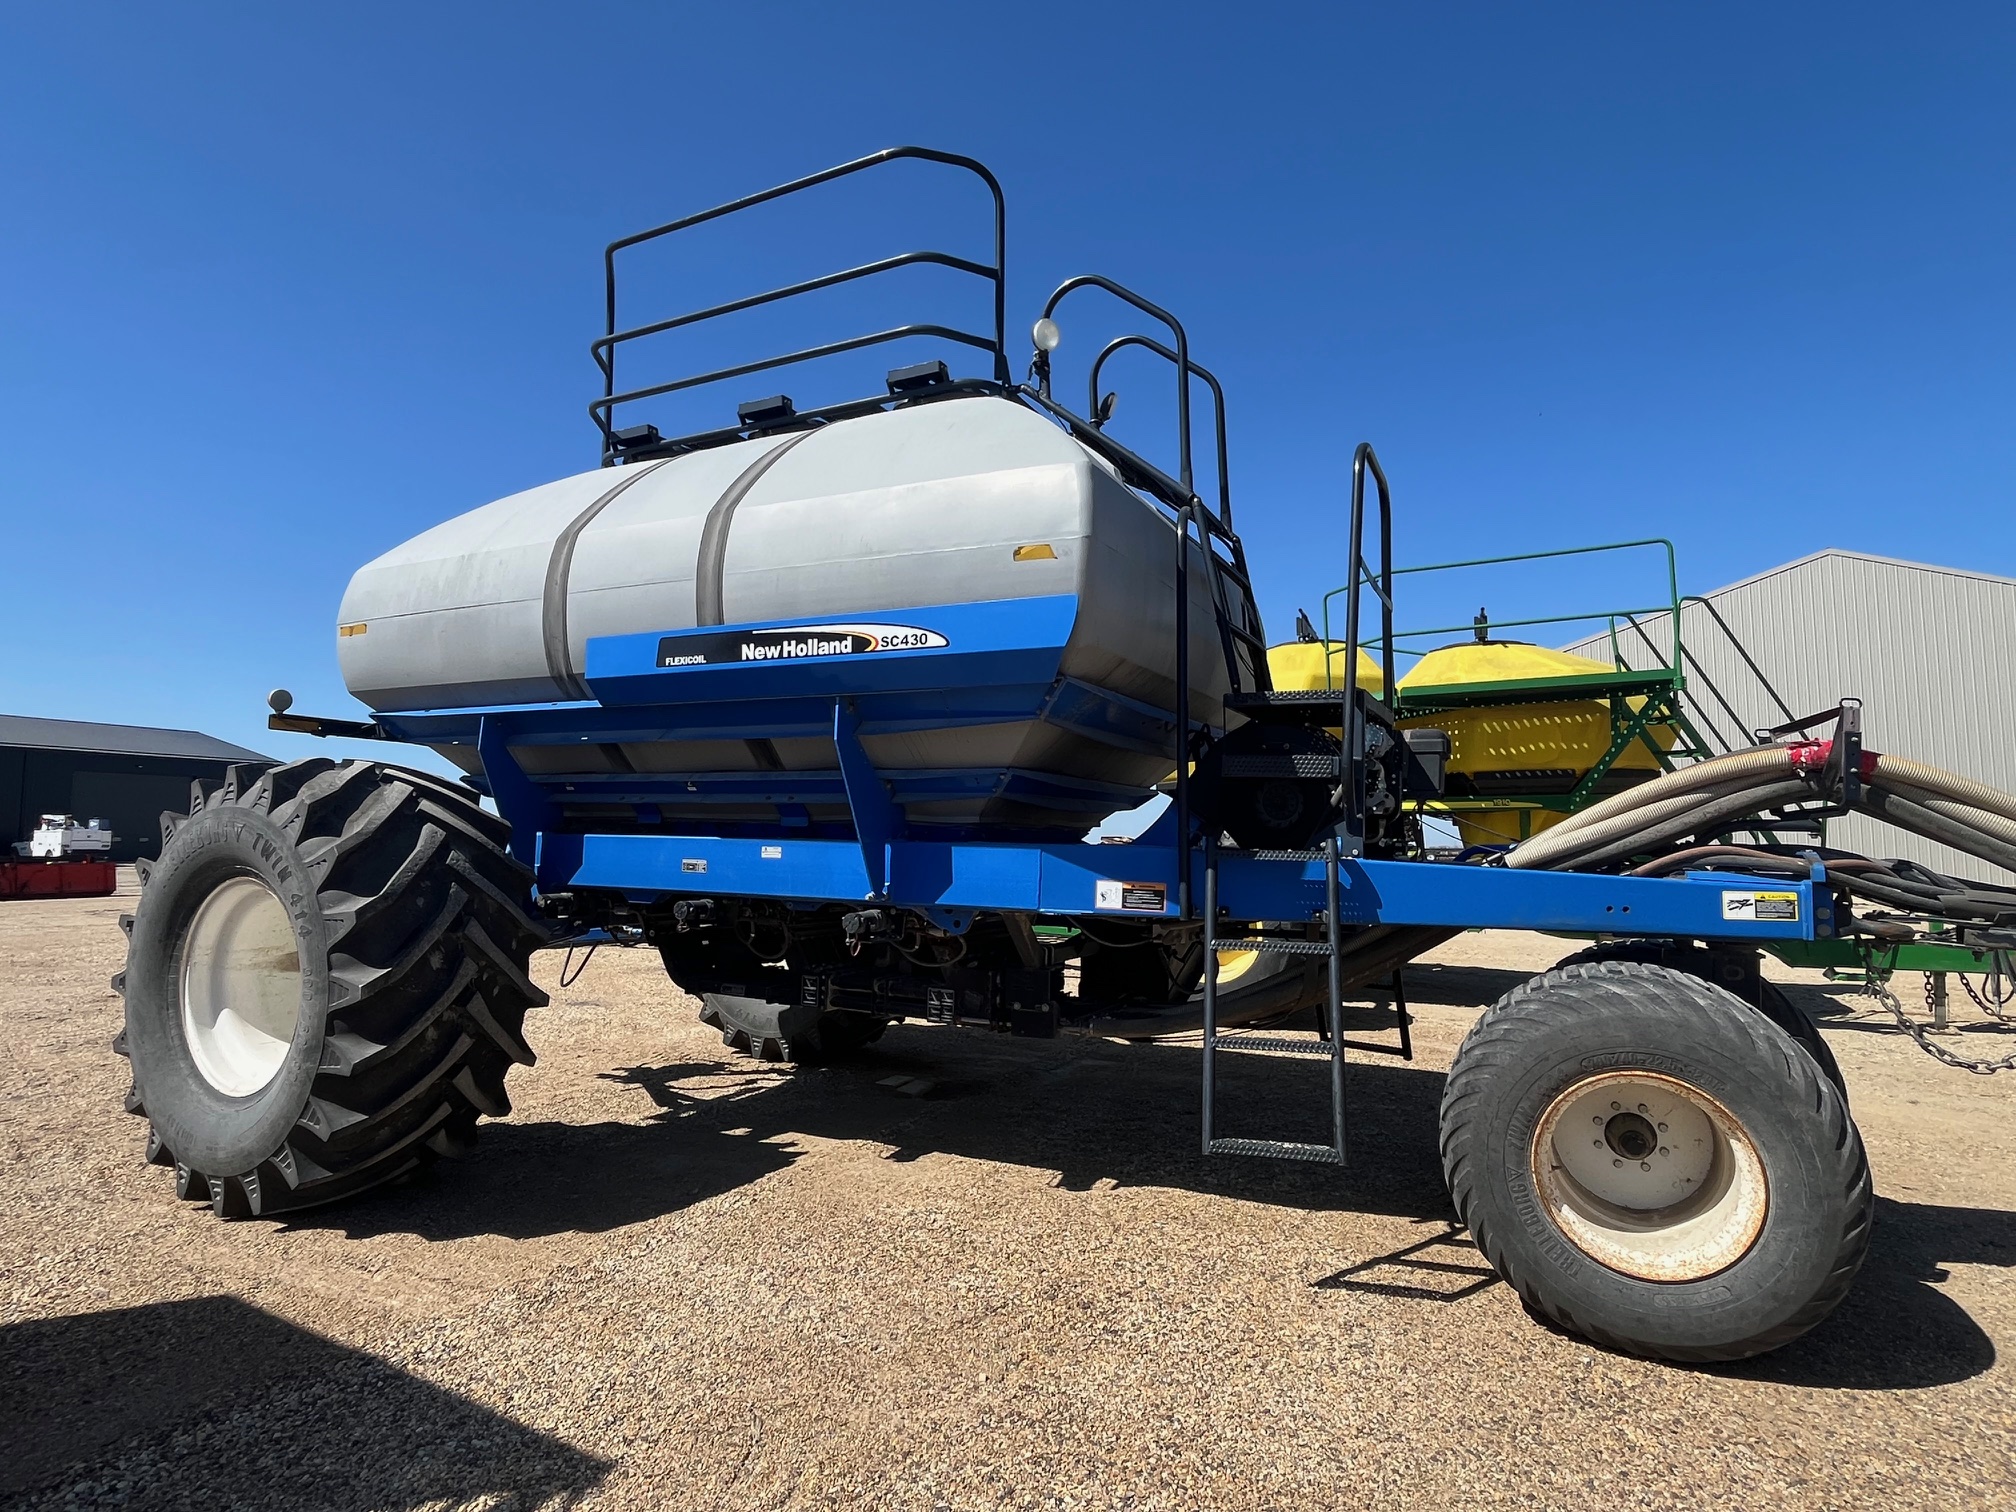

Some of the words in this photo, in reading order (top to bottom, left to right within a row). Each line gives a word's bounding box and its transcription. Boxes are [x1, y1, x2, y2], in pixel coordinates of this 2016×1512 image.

[665, 654, 707, 666] FLEXICOIL
[880, 633, 928, 648] SC430
[252, 832, 293, 885] TWIN
[290, 893, 313, 940] 414
[1511, 1182, 1584, 1281] TRELLEBORG
